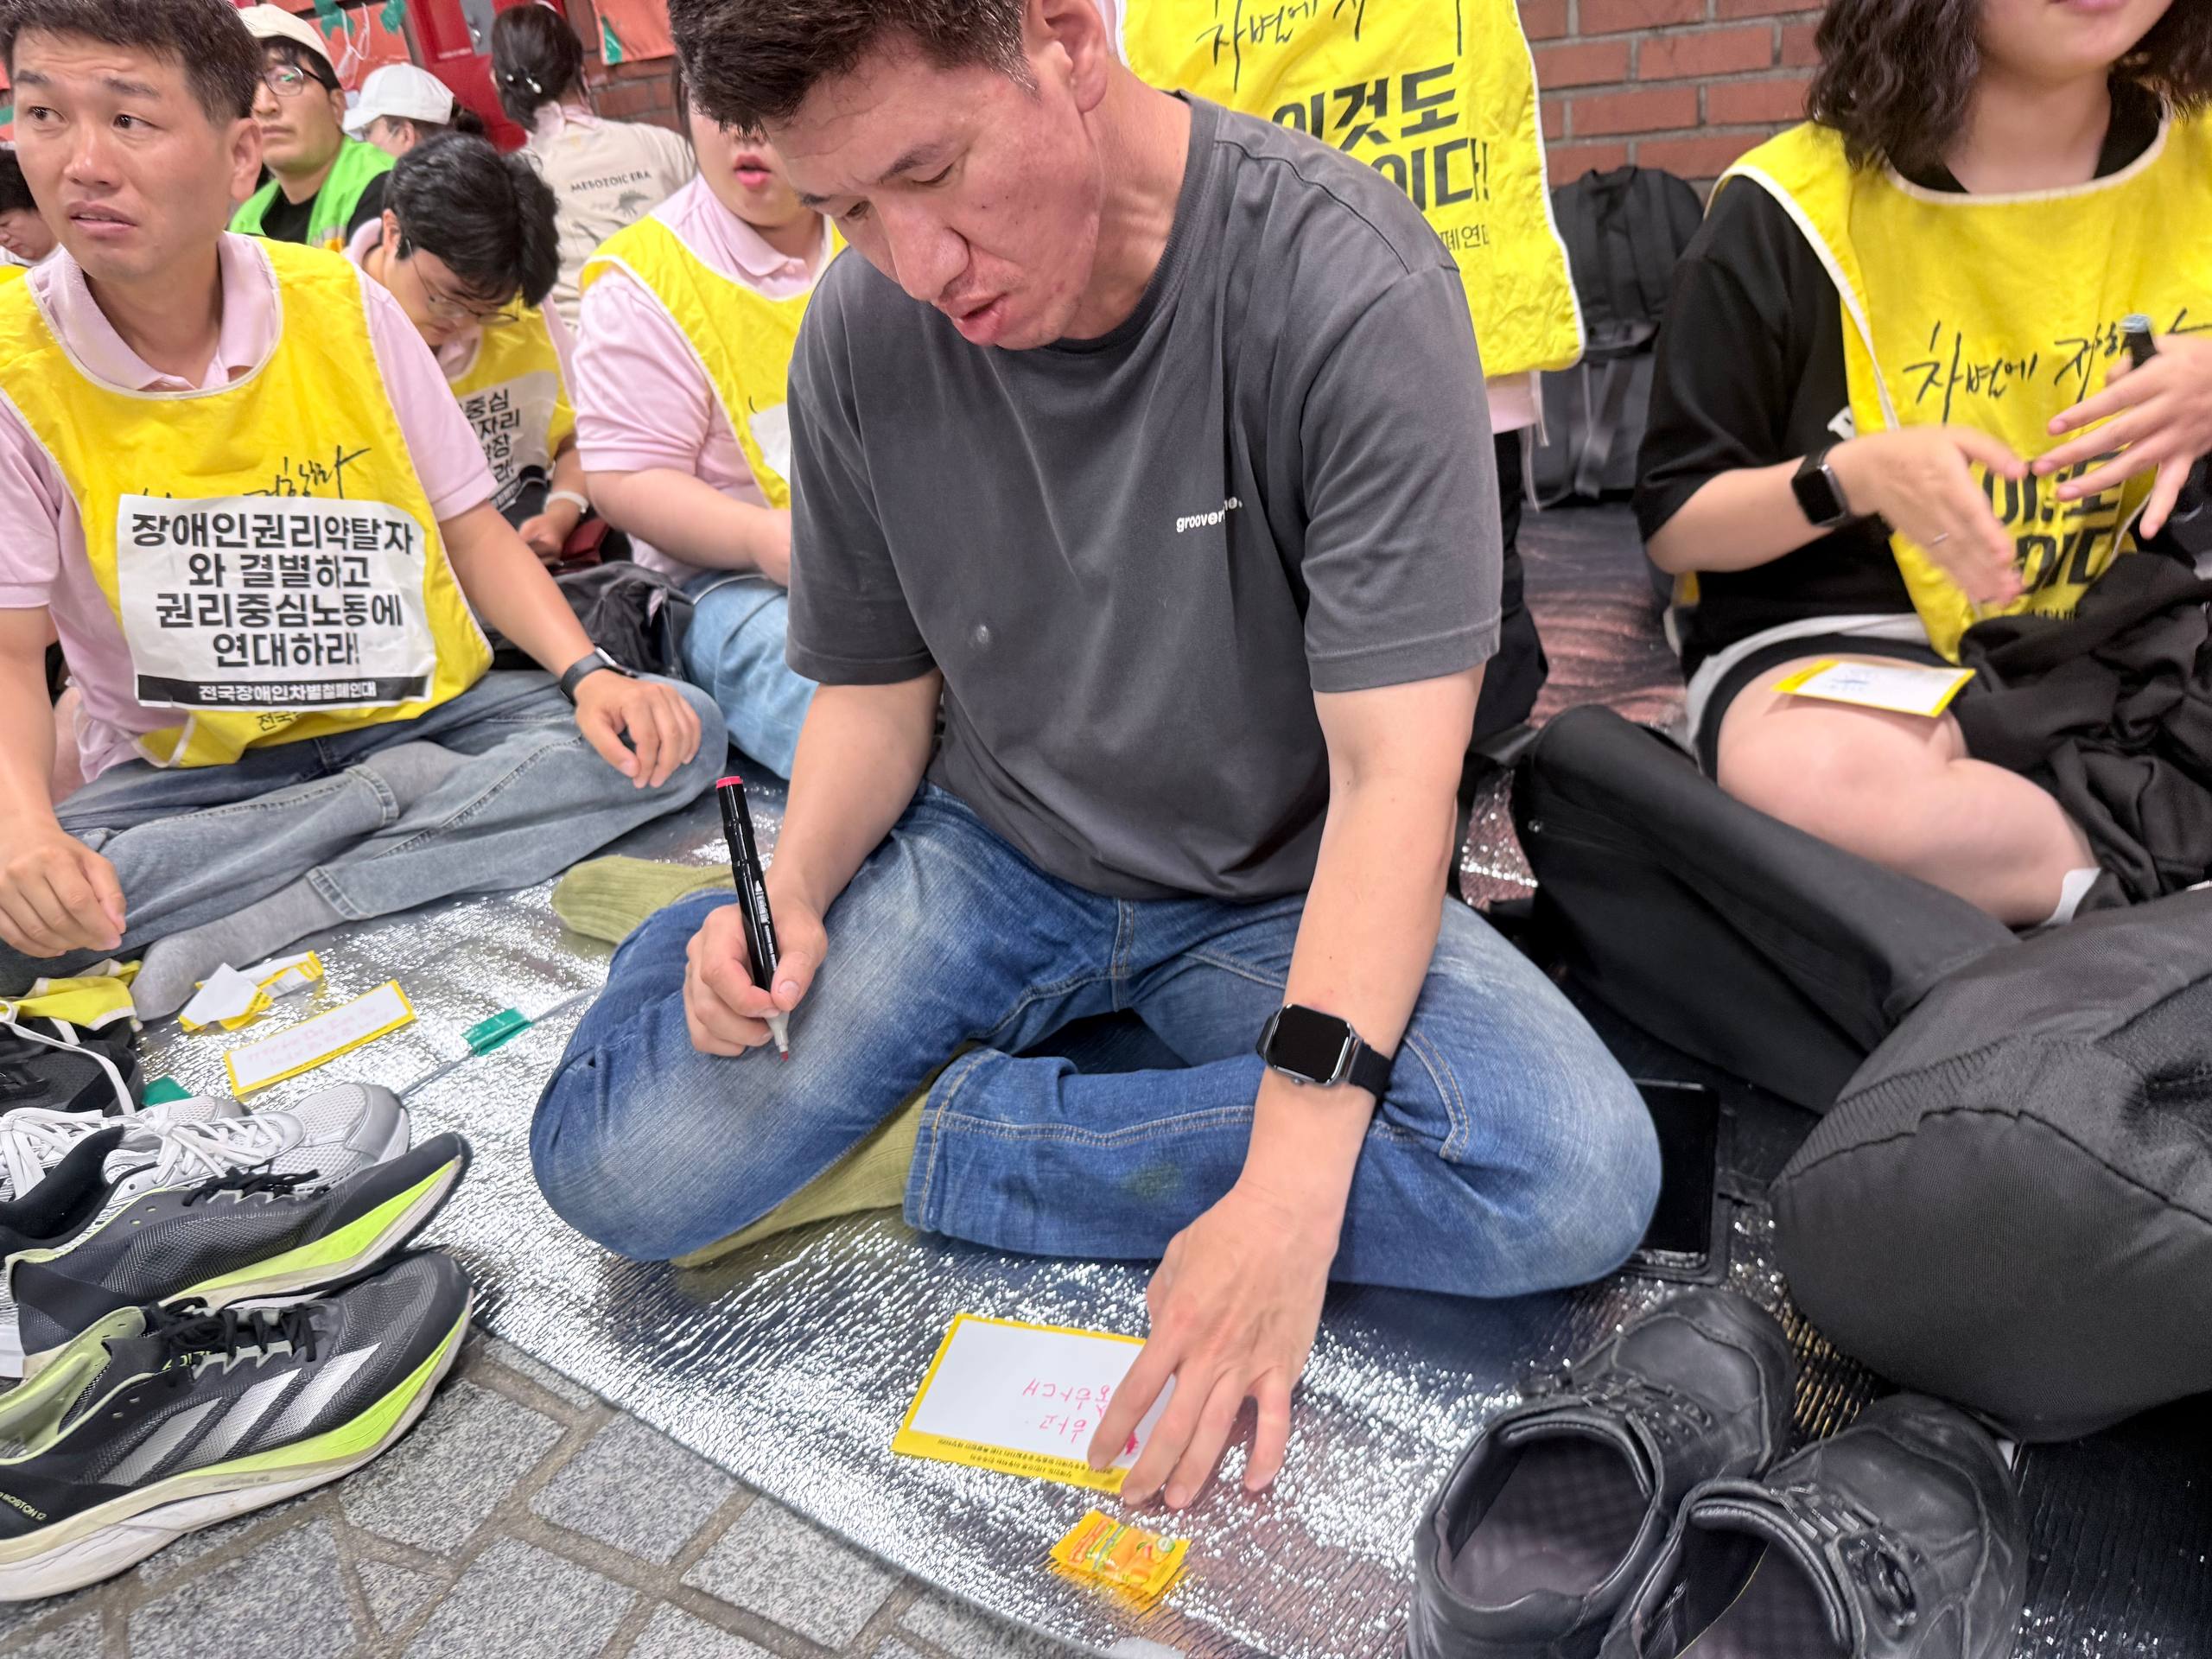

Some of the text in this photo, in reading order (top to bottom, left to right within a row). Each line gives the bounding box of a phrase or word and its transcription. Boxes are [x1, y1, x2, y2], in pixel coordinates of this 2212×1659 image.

[1272, 62, 1459, 152] 이것도
[1371, 137, 1489, 211] 이다!
[460, 389, 510, 420] 중심
[471, 410, 520, 440] 자리
[131, 512, 414, 555] 장애인권리약탈자
[188, 553, 371, 588] 와 결별하고
[156, 593, 404, 628] 권리중심노동에
[213, 632, 359, 668] 연대하라!
[256, 711, 299, 731] 전국
